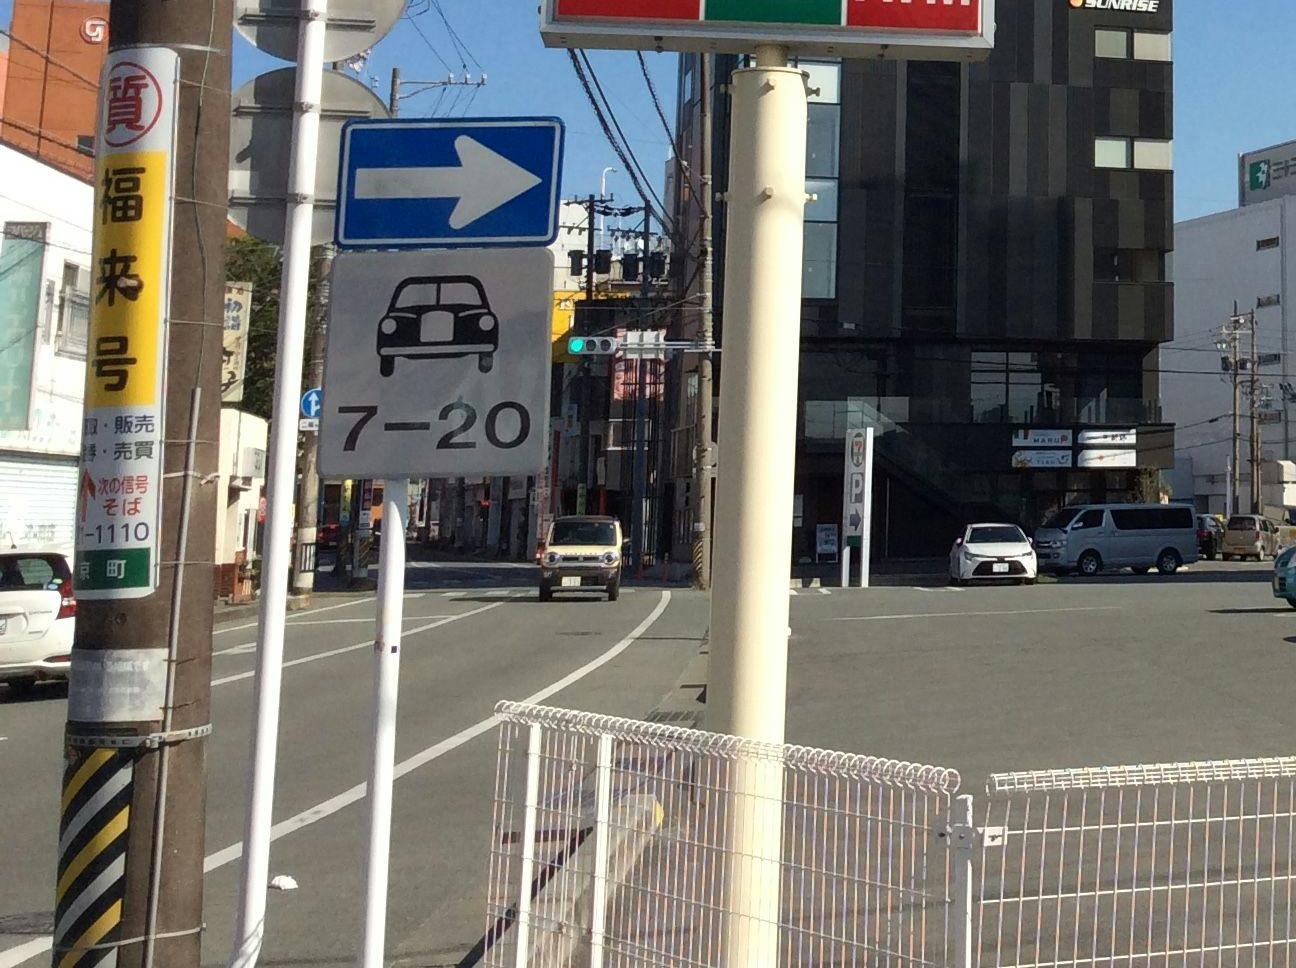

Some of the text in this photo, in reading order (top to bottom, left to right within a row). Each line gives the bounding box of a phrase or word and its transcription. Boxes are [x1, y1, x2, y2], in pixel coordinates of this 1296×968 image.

[107, 74, 150, 132] 質
[91, 166, 147, 393] 福来号
[98, 475, 150, 496] 次の信号
[102, 496, 143, 517] そば
